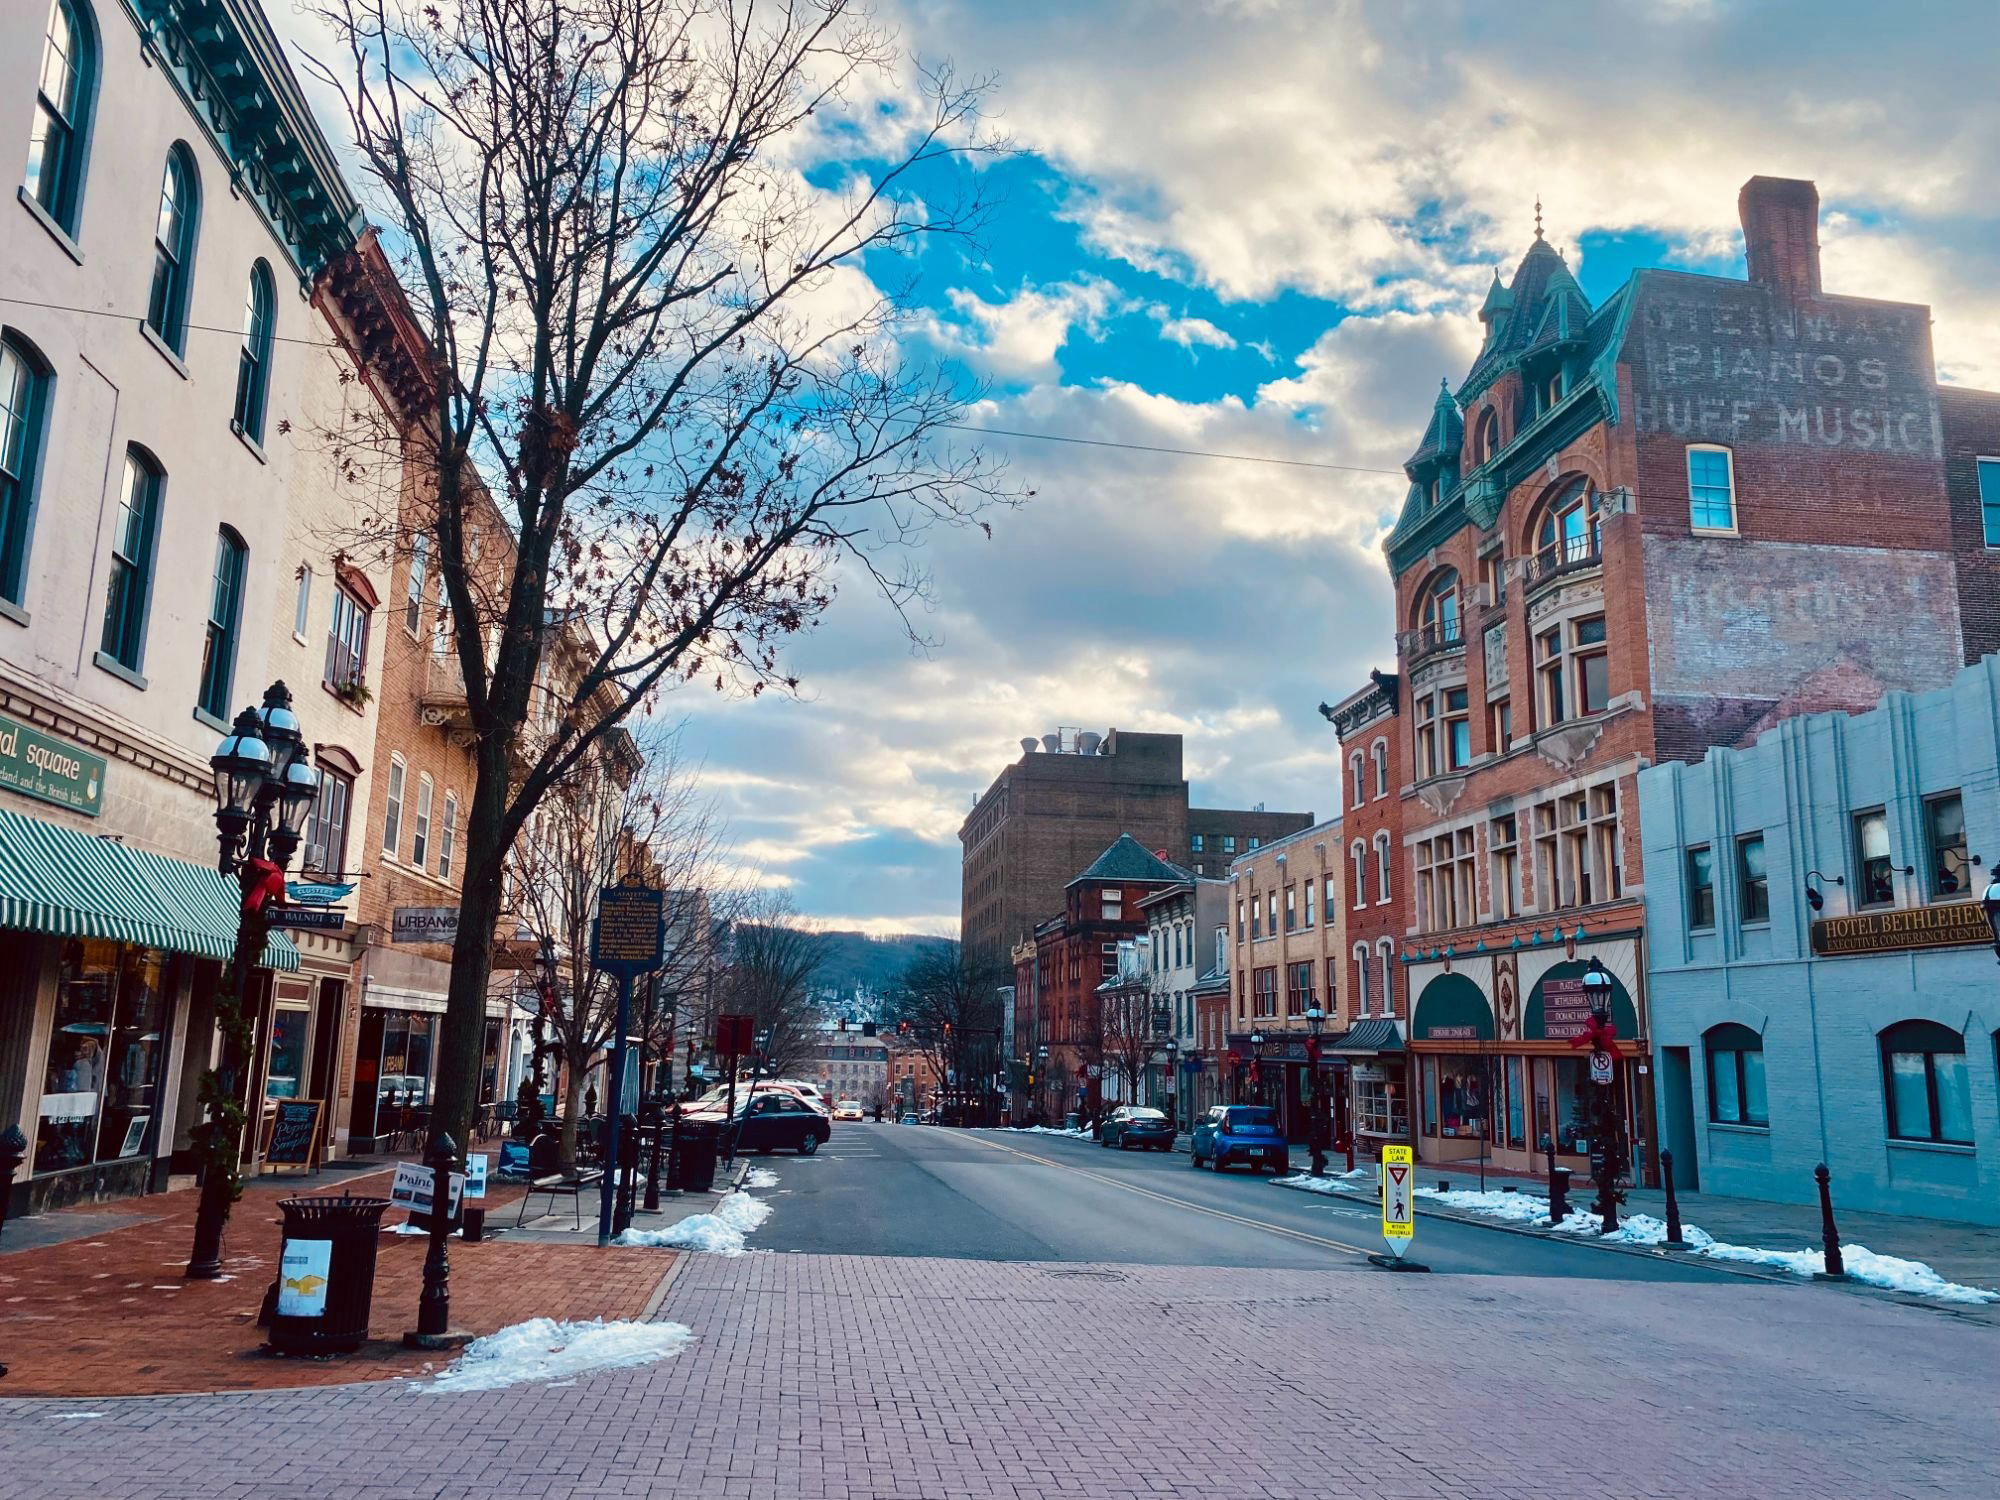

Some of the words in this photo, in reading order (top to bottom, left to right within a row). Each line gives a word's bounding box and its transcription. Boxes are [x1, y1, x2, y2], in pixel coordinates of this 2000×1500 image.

[1667, 342, 1889, 388] PIANOS
[1777, 402, 1922, 450] MUSIC
[0, 728, 18, 758] al
[26, 744, 80, 780] square
[20, 776, 34, 789] and
[35, 779, 46, 793] the
[297, 887, 334, 897] CLUSTERS
[285, 912, 325, 923] WALNUT
[331, 915, 343, 924] ST
[1825, 916, 1878, 938] HOTEL
[1881, 905, 1988, 933] BETHLEHEM
[1827, 937, 1879, 951] EXECUTIVE
[1879, 929, 1948, 949] CONFERENCE
[1949, 925, 1993, 940] CENTER
[399, 1172, 432, 1188] Paint
